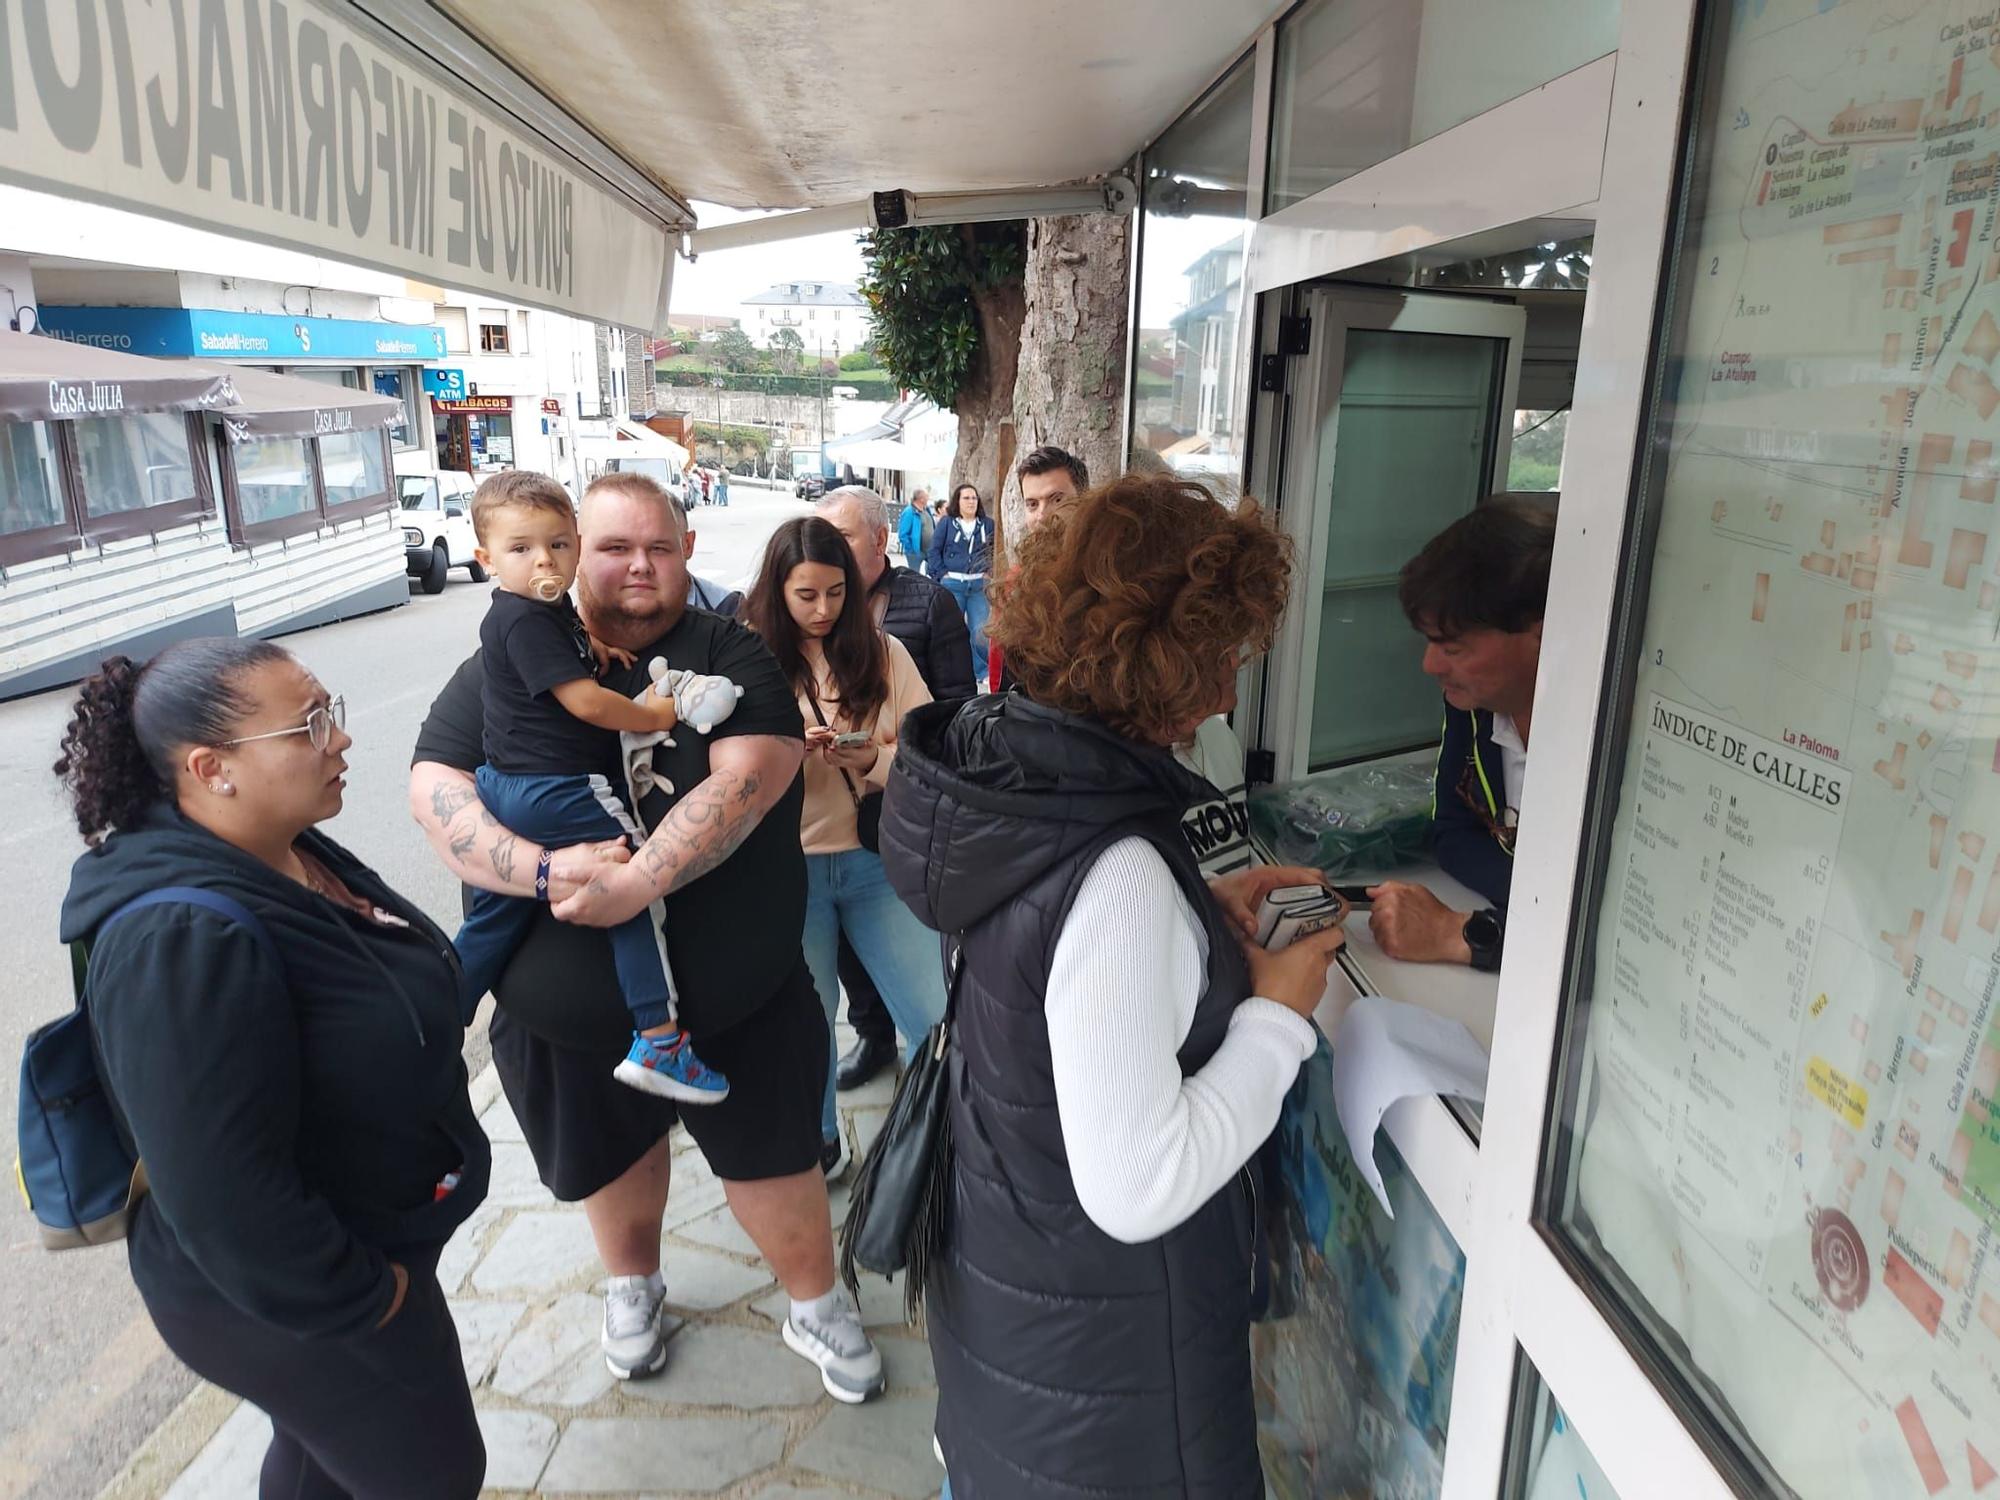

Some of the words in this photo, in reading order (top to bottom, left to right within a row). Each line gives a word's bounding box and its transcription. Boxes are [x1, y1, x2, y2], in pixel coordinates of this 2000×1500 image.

[1710, 256, 1720, 276] 2
[88, 381, 125, 412] JULIA
[439, 389, 463, 400] ATM
[454, 398, 508, 407] TABACOS
[1655, 648, 1664, 666] 3
[1651, 700, 1719, 753] ÍNDICE
[1719, 734, 1749, 767] DE
[1752, 750, 1841, 806] CALLES
[1782, 727, 1797, 745] La
[1799, 733, 1841, 761] Paloma
[1905, 953, 1925, 998] Penzol
[1955, 1031, 1979, 1081] Párroco
